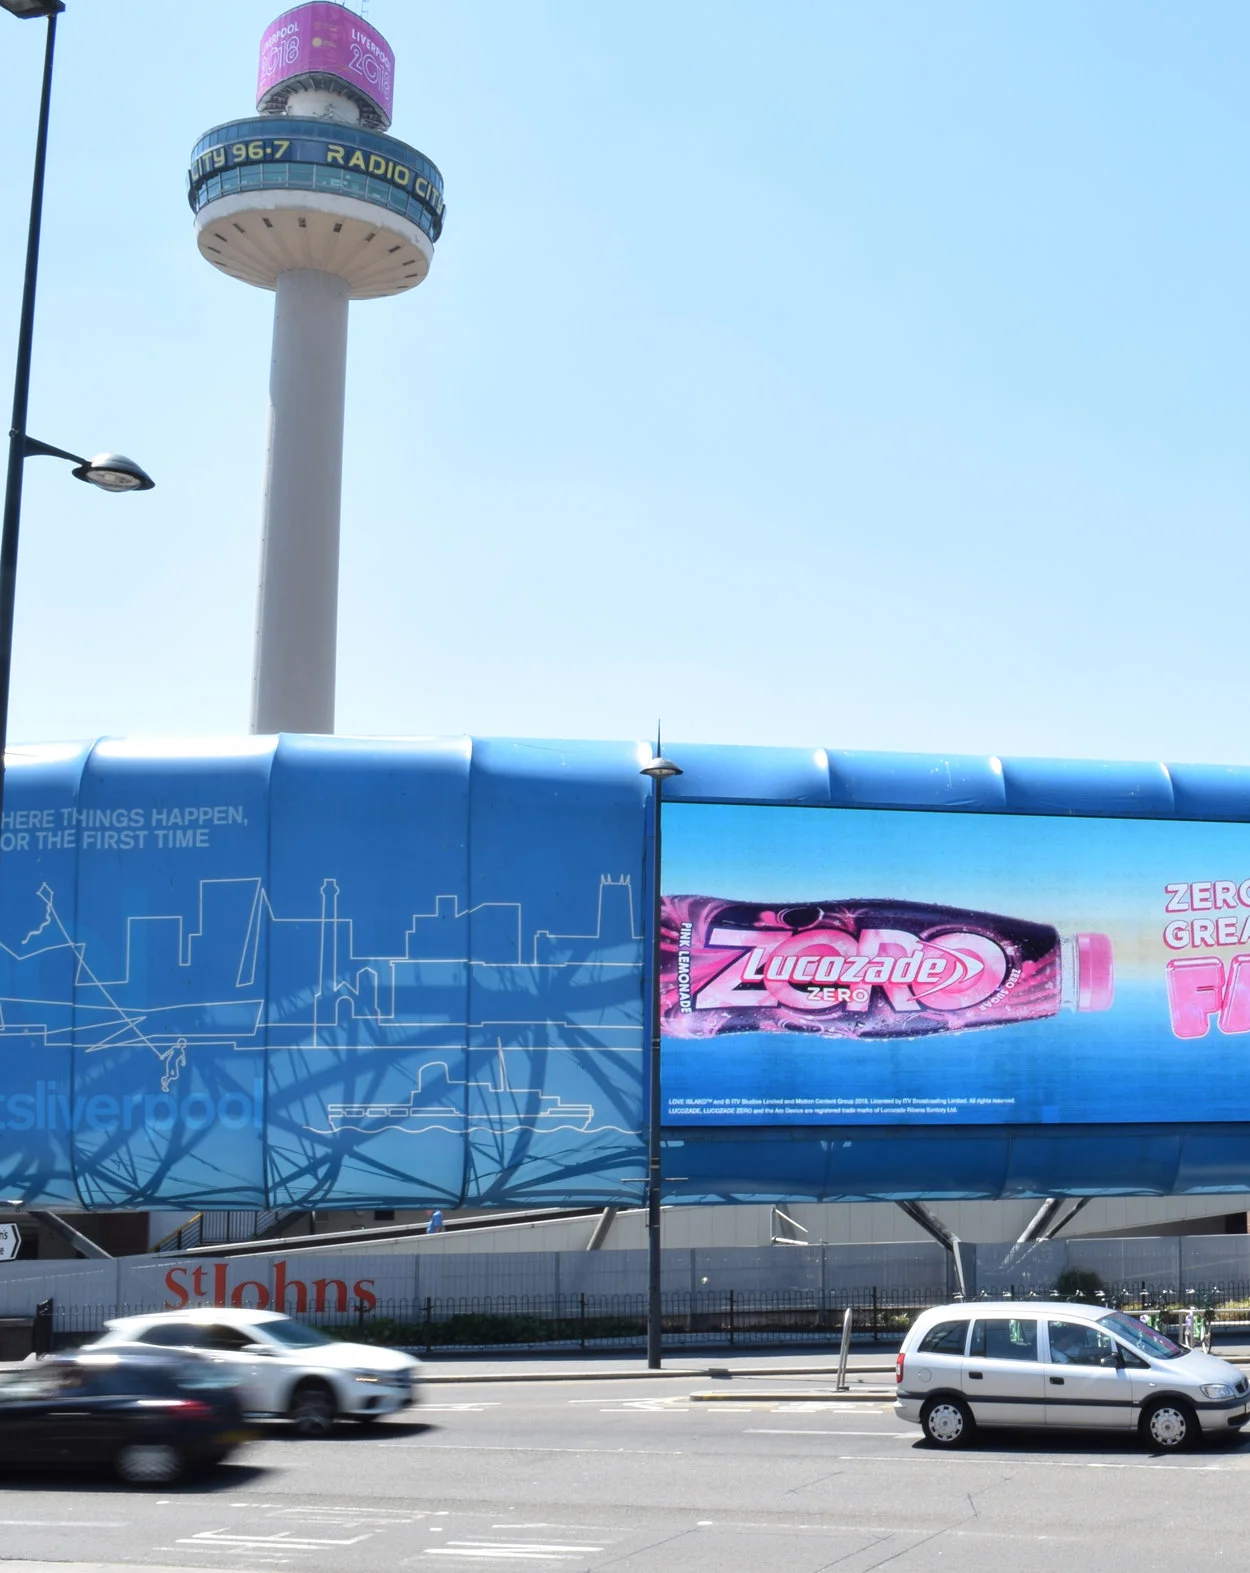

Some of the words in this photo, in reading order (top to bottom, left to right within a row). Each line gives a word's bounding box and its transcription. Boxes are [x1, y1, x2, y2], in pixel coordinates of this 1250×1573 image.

[190, 146, 226, 181] CITY
[326, 144, 410, 186] RADIO
[415, 178, 444, 214] CITY
[60, 807, 145, 828] THINGS
[151, 805, 249, 827] HAPPEN,
[36, 829, 77, 850] THE
[83, 830, 149, 850] FIRST
[154, 828, 210, 848] TIME
[679, 922, 693, 948] PINK
[742, 947, 948, 985] Lucozade
[677, 950, 693, 1014] LEMONADE
[806, 985, 870, 1003] ZERO
